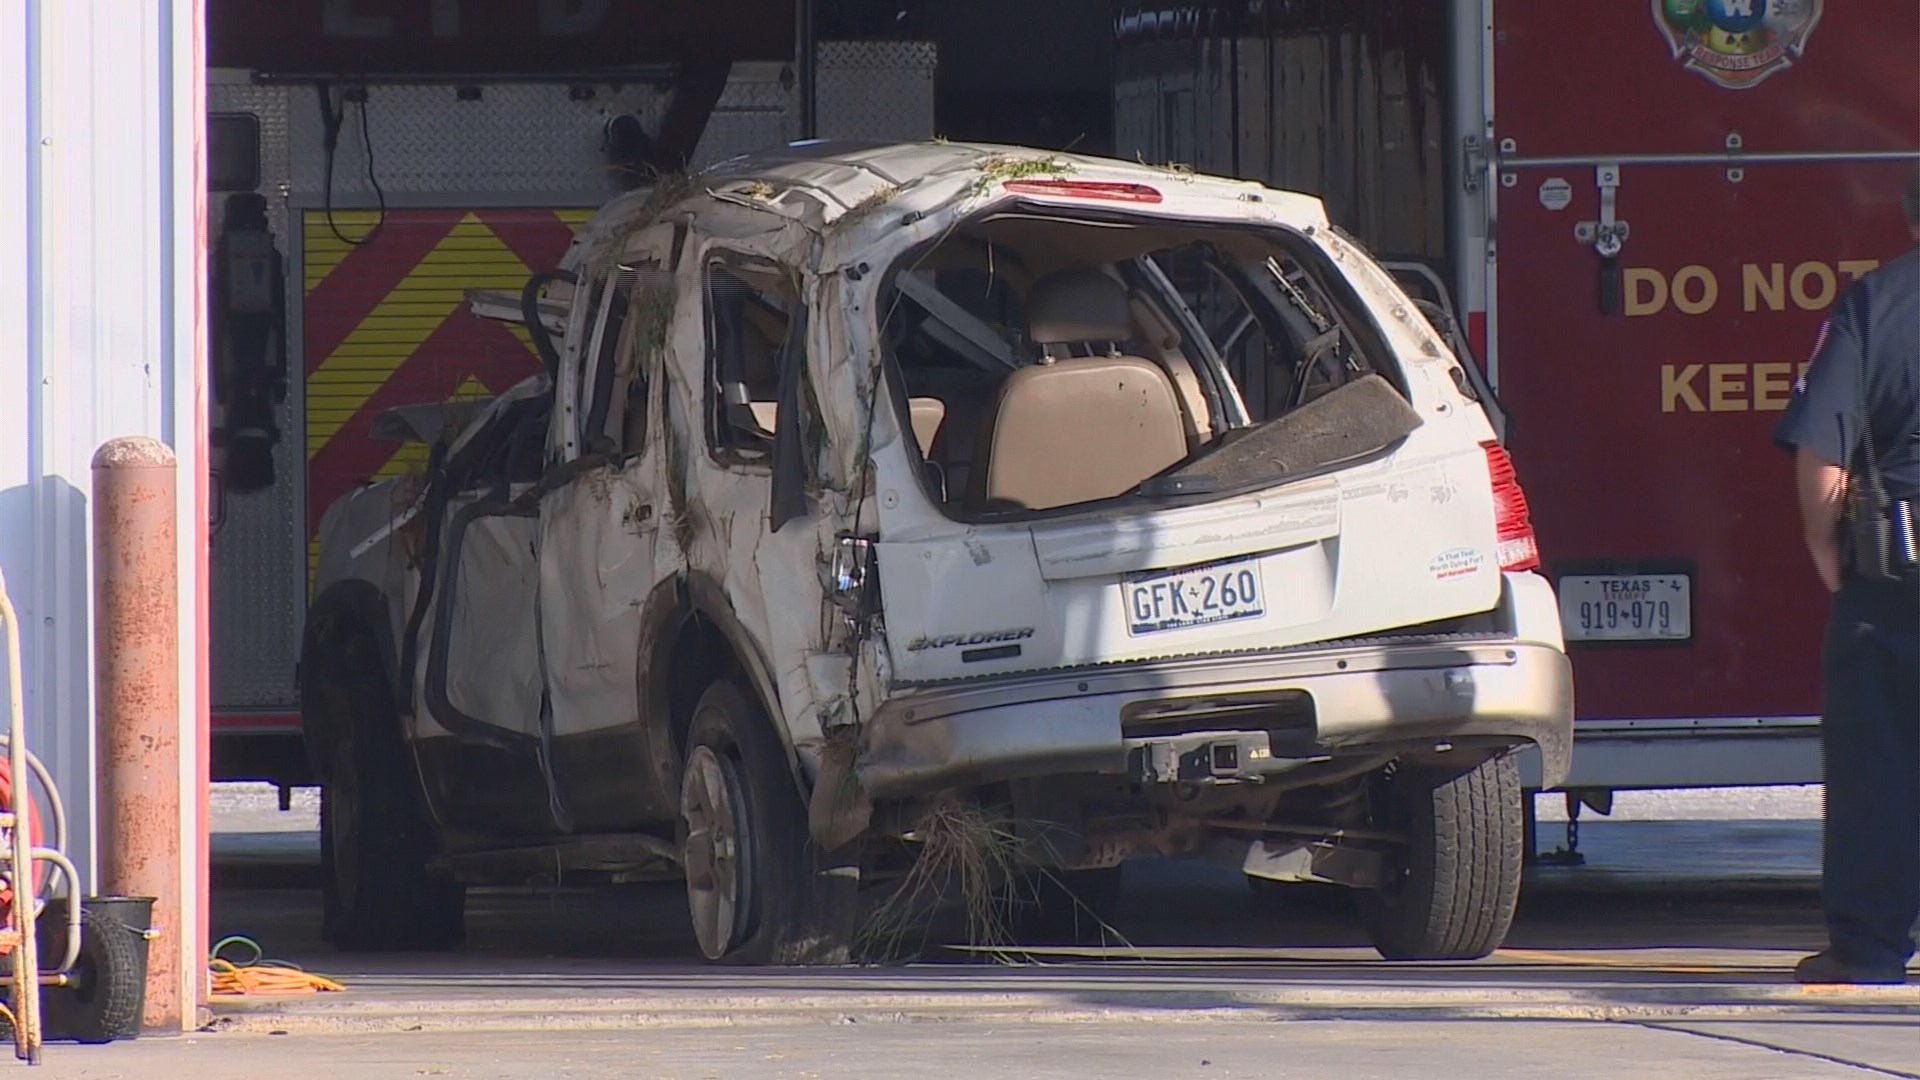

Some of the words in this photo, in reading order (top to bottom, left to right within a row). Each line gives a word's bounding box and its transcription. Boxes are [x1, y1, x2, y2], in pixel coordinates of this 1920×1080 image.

[1694, 47, 1749, 68] RESPONSE
[1623, 265, 1718, 316] DO
[1661, 363, 1809, 412] KEE
[1133, 580, 1188, 621] GFK
[1200, 569, 1256, 611] 260
[1601, 580, 1650, 593] TEXAS
[1580, 601, 1617, 629] 919
[1631, 601, 1670, 629] 979
[907, 627, 1035, 652] EXPLORER
